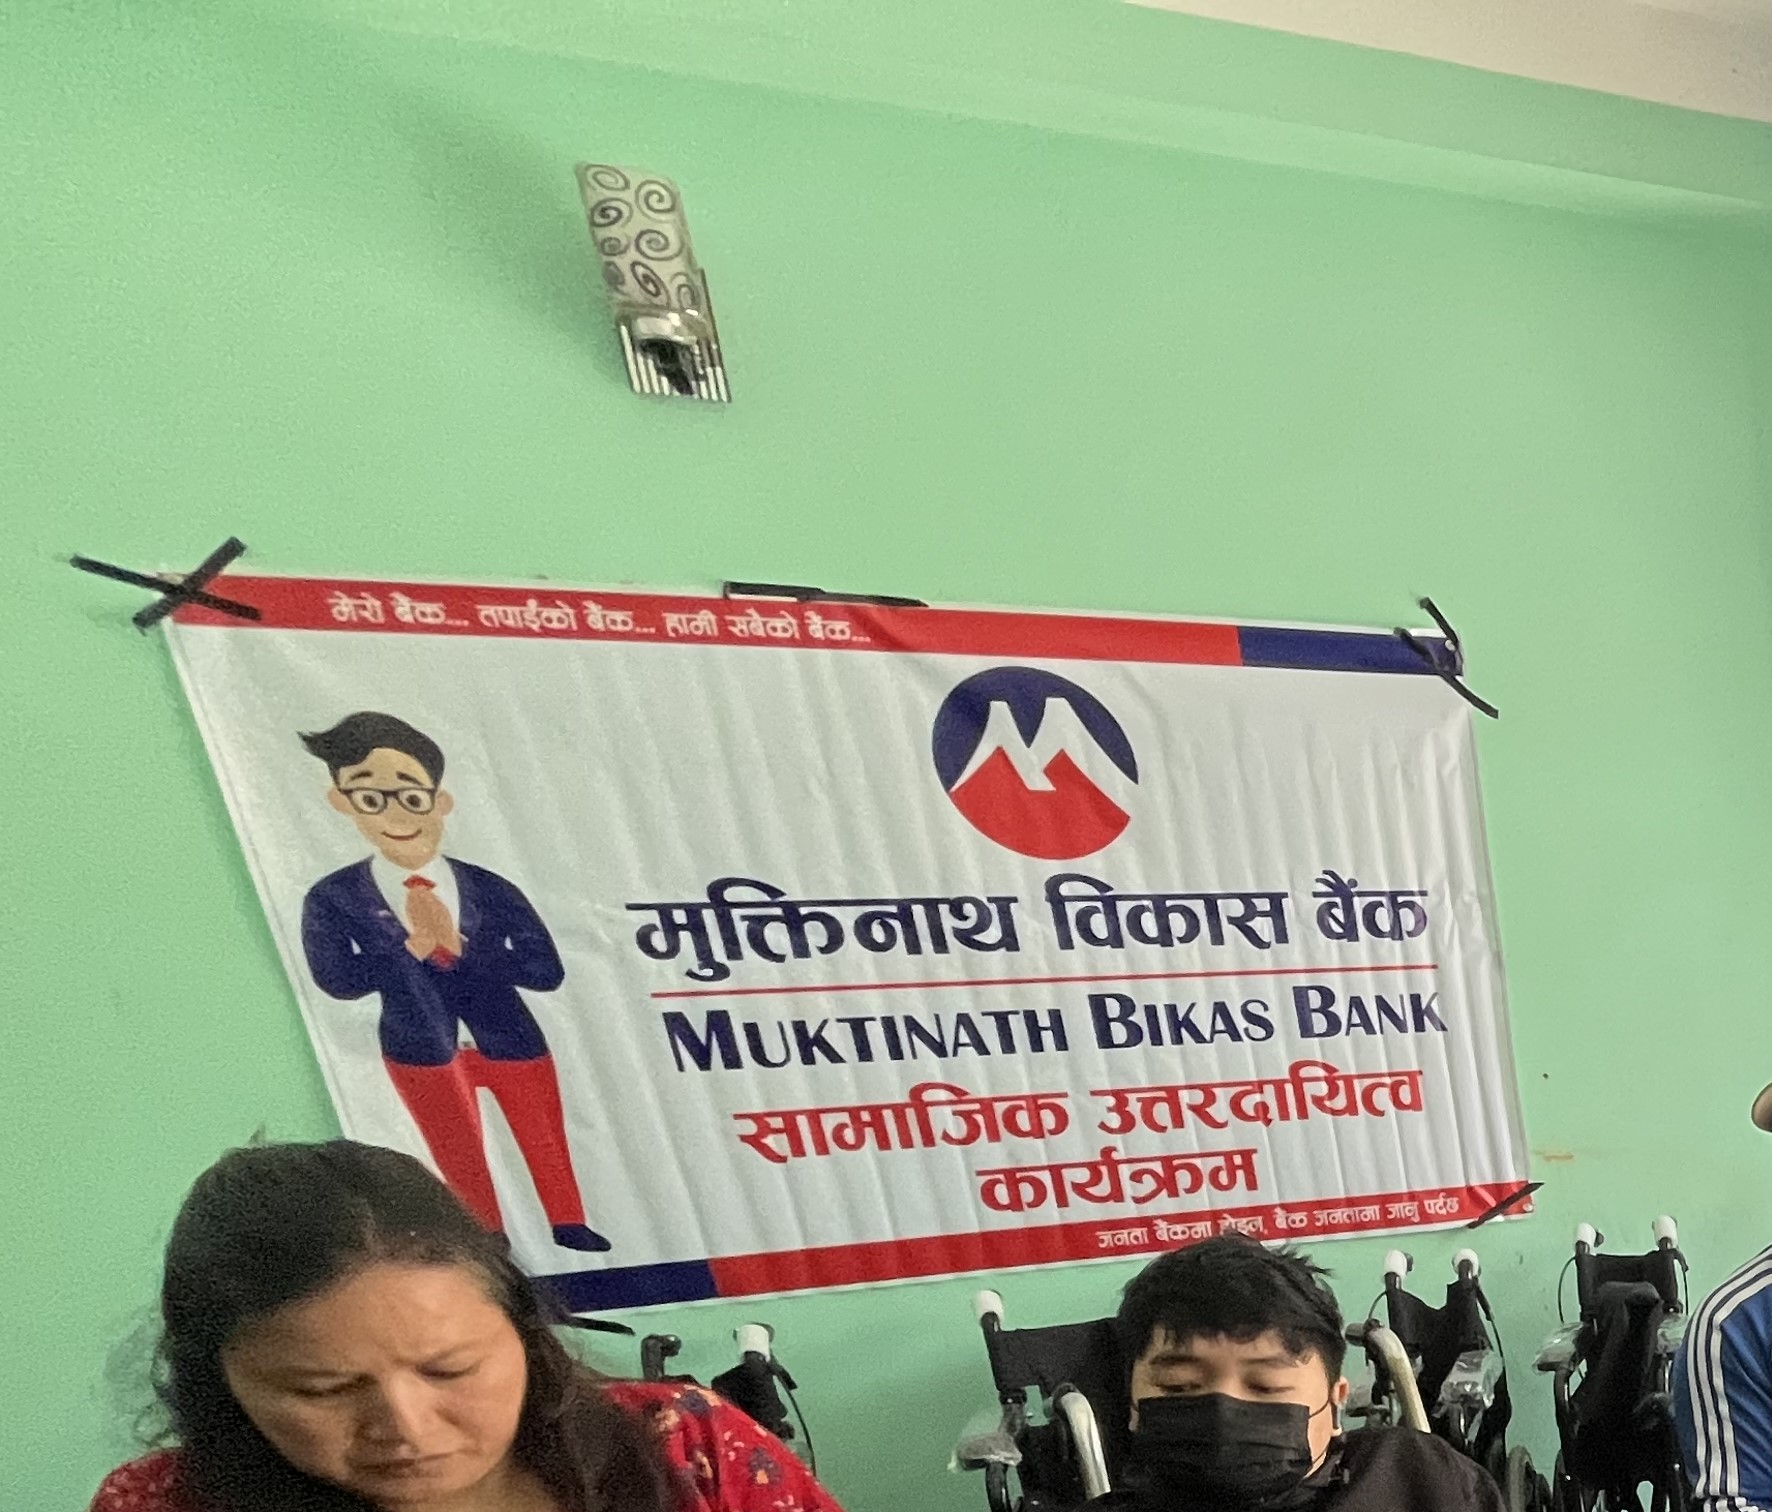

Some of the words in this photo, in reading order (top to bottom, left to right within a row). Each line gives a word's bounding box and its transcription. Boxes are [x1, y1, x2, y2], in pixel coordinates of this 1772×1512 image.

[327, 590, 385, 624] मेरो
[662, 609, 719, 637] हामी
[626, 876, 1018, 982] मुक्तिनाथ
[1044, 872, 1289, 951] विकास
[1312, 869, 1429, 942] बैंक
[663, 1007, 1067, 1073] MUKTINATH
[1087, 991, 1276, 1052] BIKAS
[1291, 983, 1449, 1042] BANK
[733, 1081, 1070, 1165] सामाजिक
[1090, 1059, 1424, 1136] उत्तरदायित्व
[977, 1147, 1259, 1214] कार्यक्रम
[1096, 1227, 1149, 1250] जनता
[1313, 1207, 1381, 1229] जनतामा
[1387, 1203, 1420, 1224] जानु
